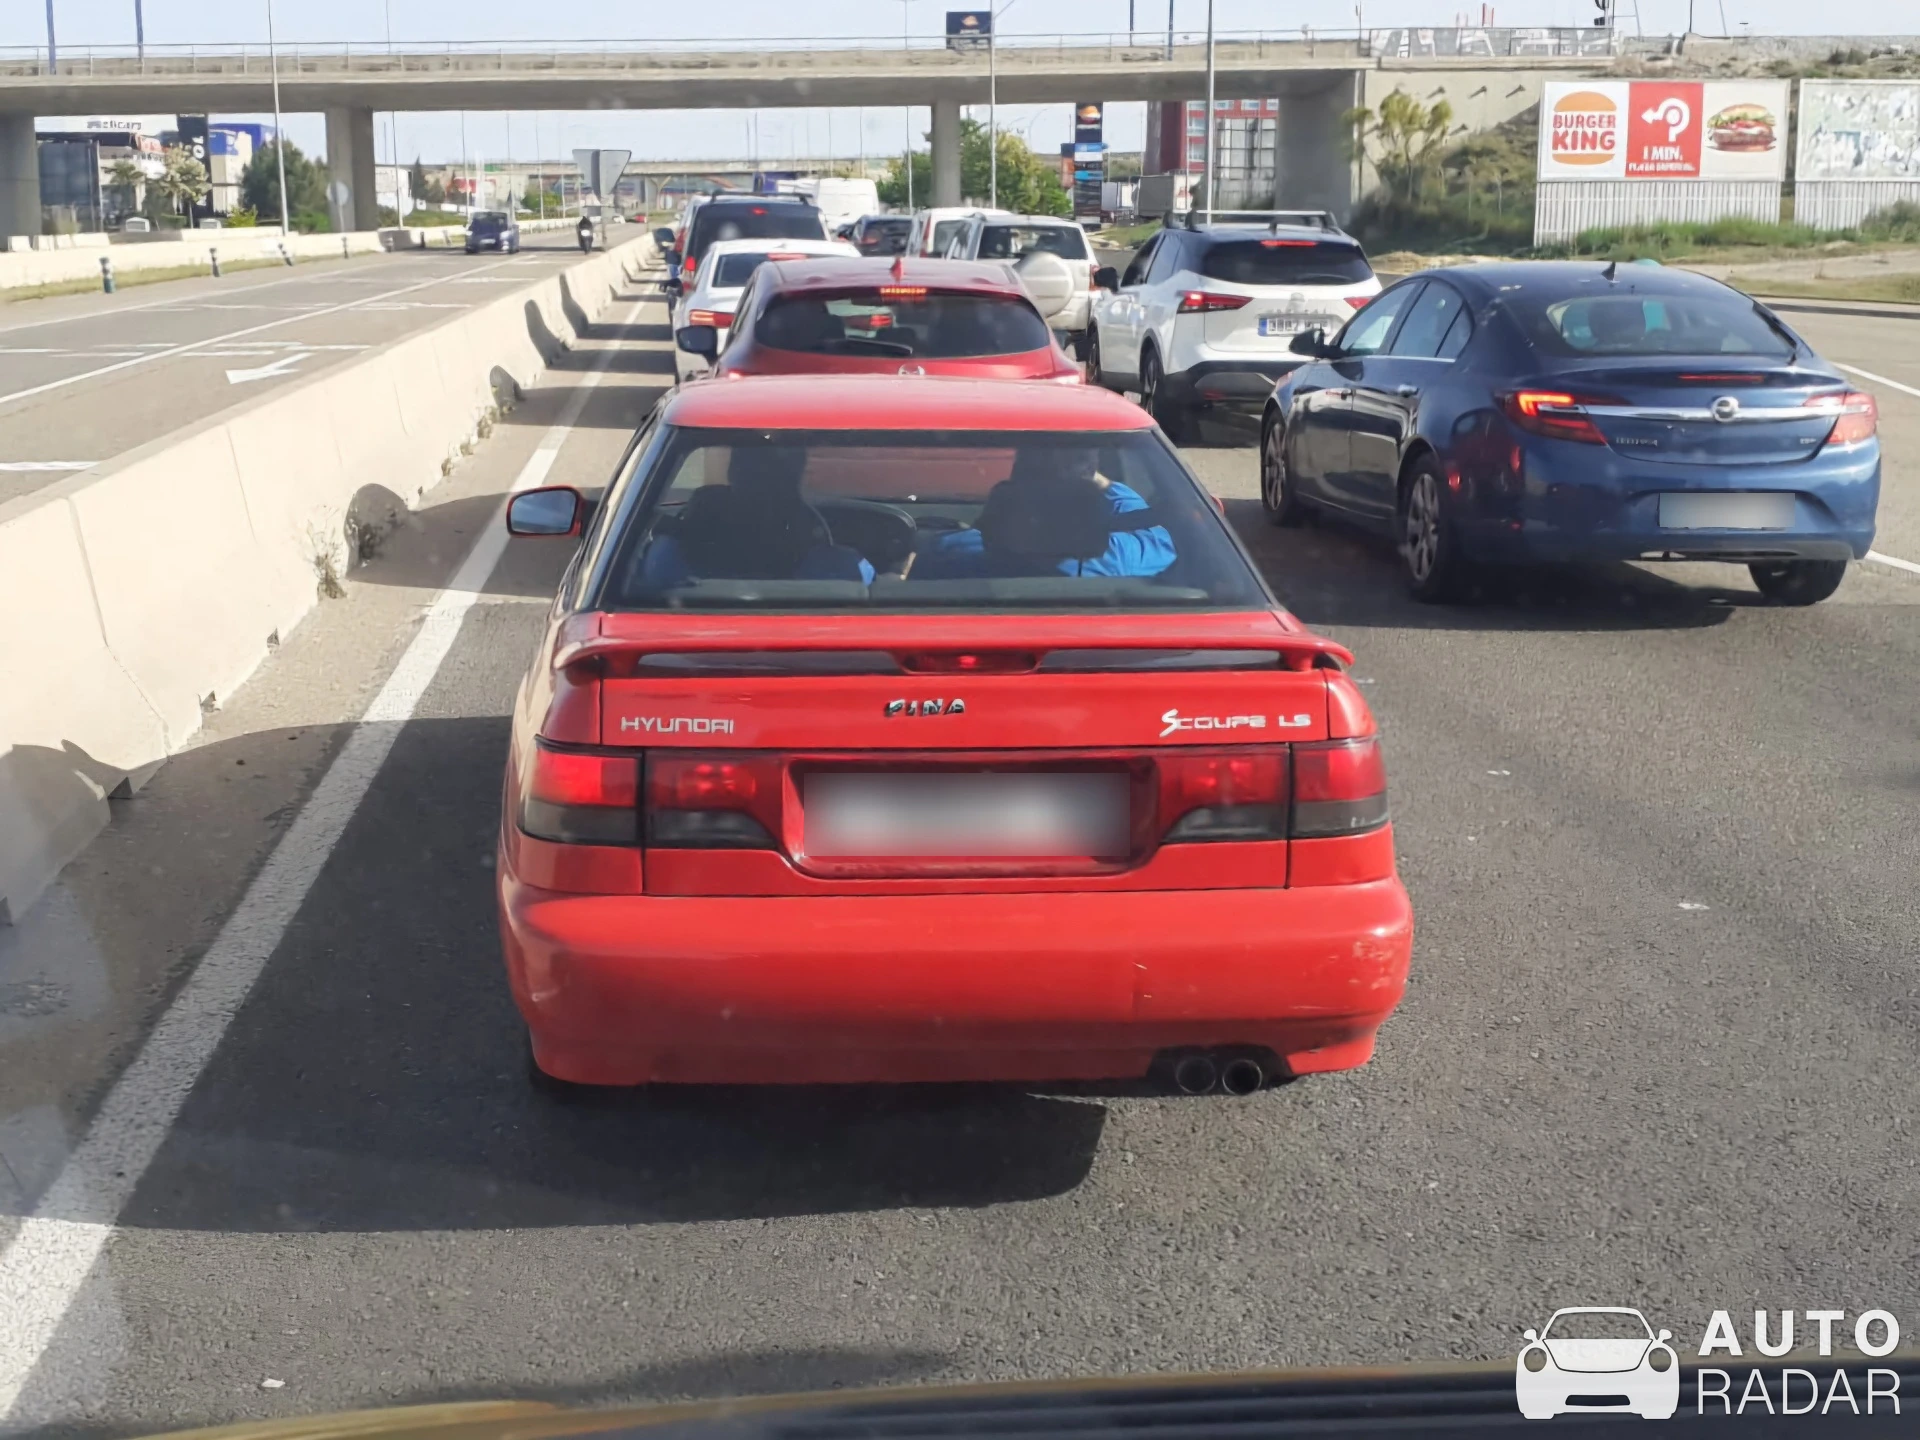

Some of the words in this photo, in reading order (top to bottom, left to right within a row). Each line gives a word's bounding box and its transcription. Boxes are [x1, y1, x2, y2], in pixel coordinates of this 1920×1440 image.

[1553, 114, 1616, 128] BURGER
[1552, 131, 1615, 150] KING
[621, 717, 734, 733] HYUNDAI
[1279, 714, 1311, 727] LS
